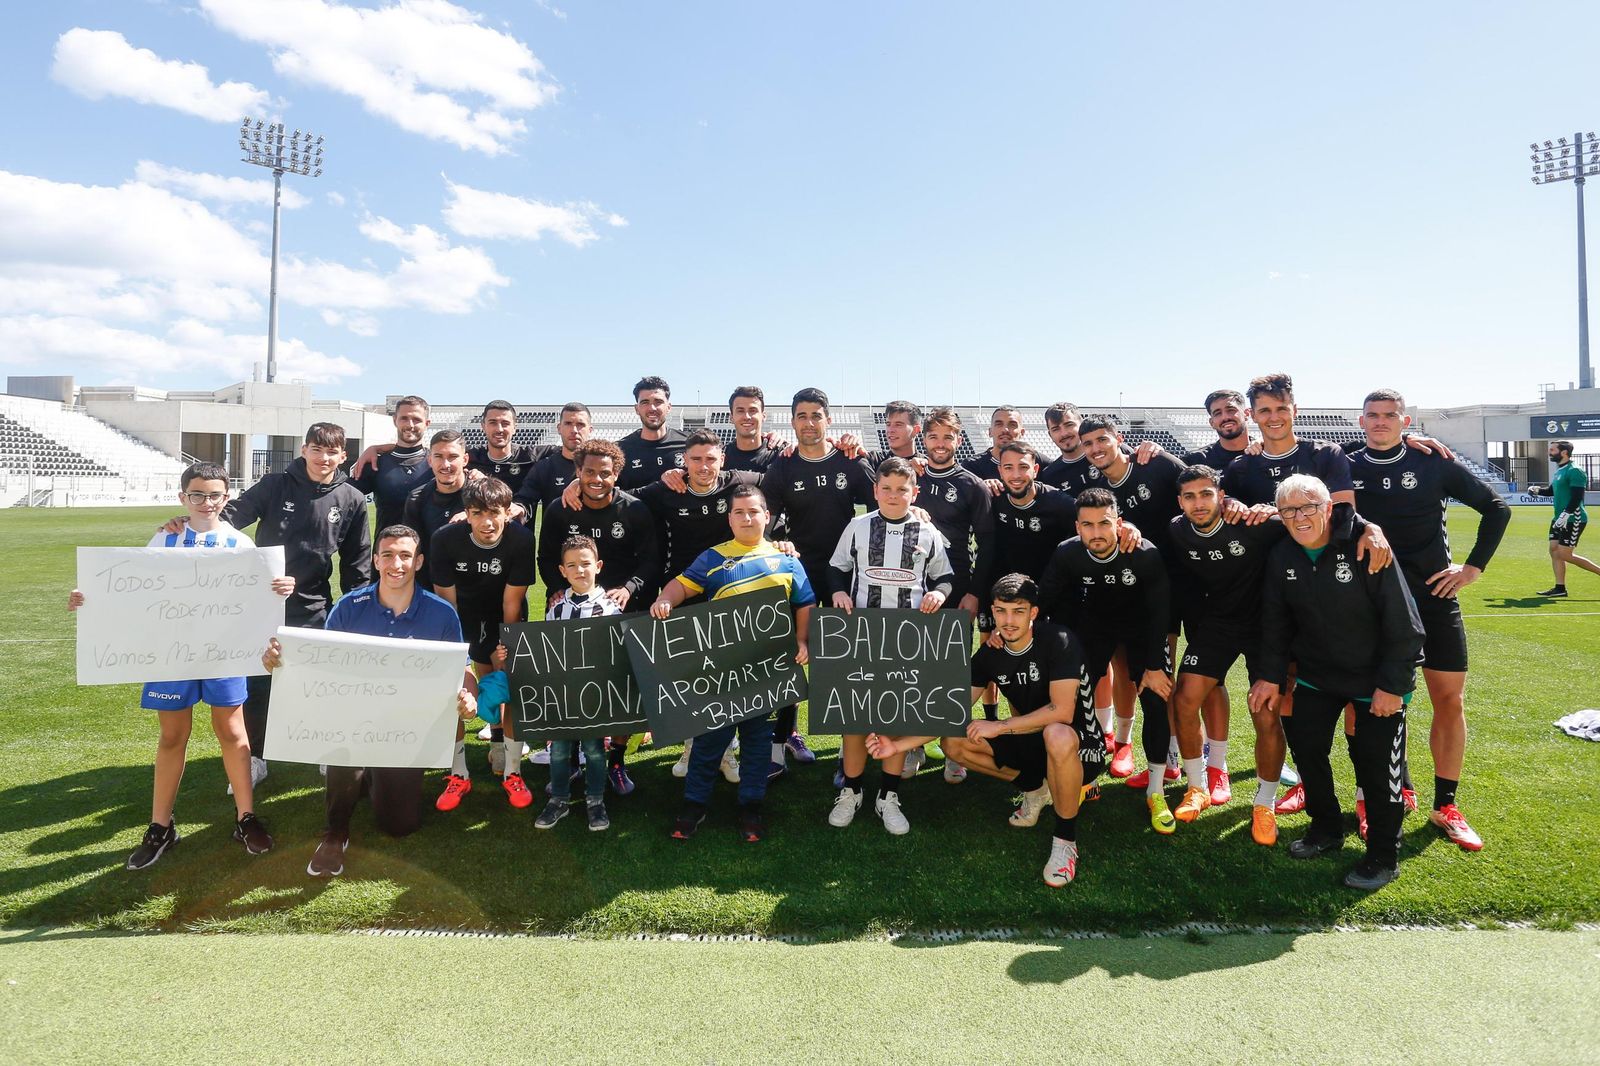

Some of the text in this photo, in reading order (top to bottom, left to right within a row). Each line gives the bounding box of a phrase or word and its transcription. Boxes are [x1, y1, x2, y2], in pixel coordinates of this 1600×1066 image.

[657, 456, 663, 466] 6
[494, 465, 501, 473] 5
[1269, 466, 1281, 477] 15
[815, 475, 827, 487] 13
[1382, 477, 1392, 490] 9
[930, 483, 939, 496] 11
[1126, 497, 1139, 509] 27
[702, 505, 709, 515] 8
[1015, 518, 1024, 529] 18
[591, 528, 601, 538] 10
[182, 538, 220, 546] GIVOVA
[1208, 550, 1224, 561] 26
[476, 561, 489, 573] 19
[96, 559, 259, 593] TODOS JUNTOS
[1104, 574, 1116, 584] 23
[146, 599, 244, 620] PODEMOS
[629, 599, 793, 665] VENIMOS
[815, 613, 968, 667] BALONA
[292, 643, 438, 672] SIEMPRE CON
[703, 655, 715, 671] A
[1183, 655, 1199, 666] 26
[846, 666, 920, 685] de mis
[1016, 672, 1027, 685] 17
[657, 651, 789, 715] APOYARTE
[303, 681, 398, 698] VOSOTROS
[148, 691, 181, 701] GIVOVA
[518, 674, 642, 723] BALON
[823, 686, 967, 726] AMORES
